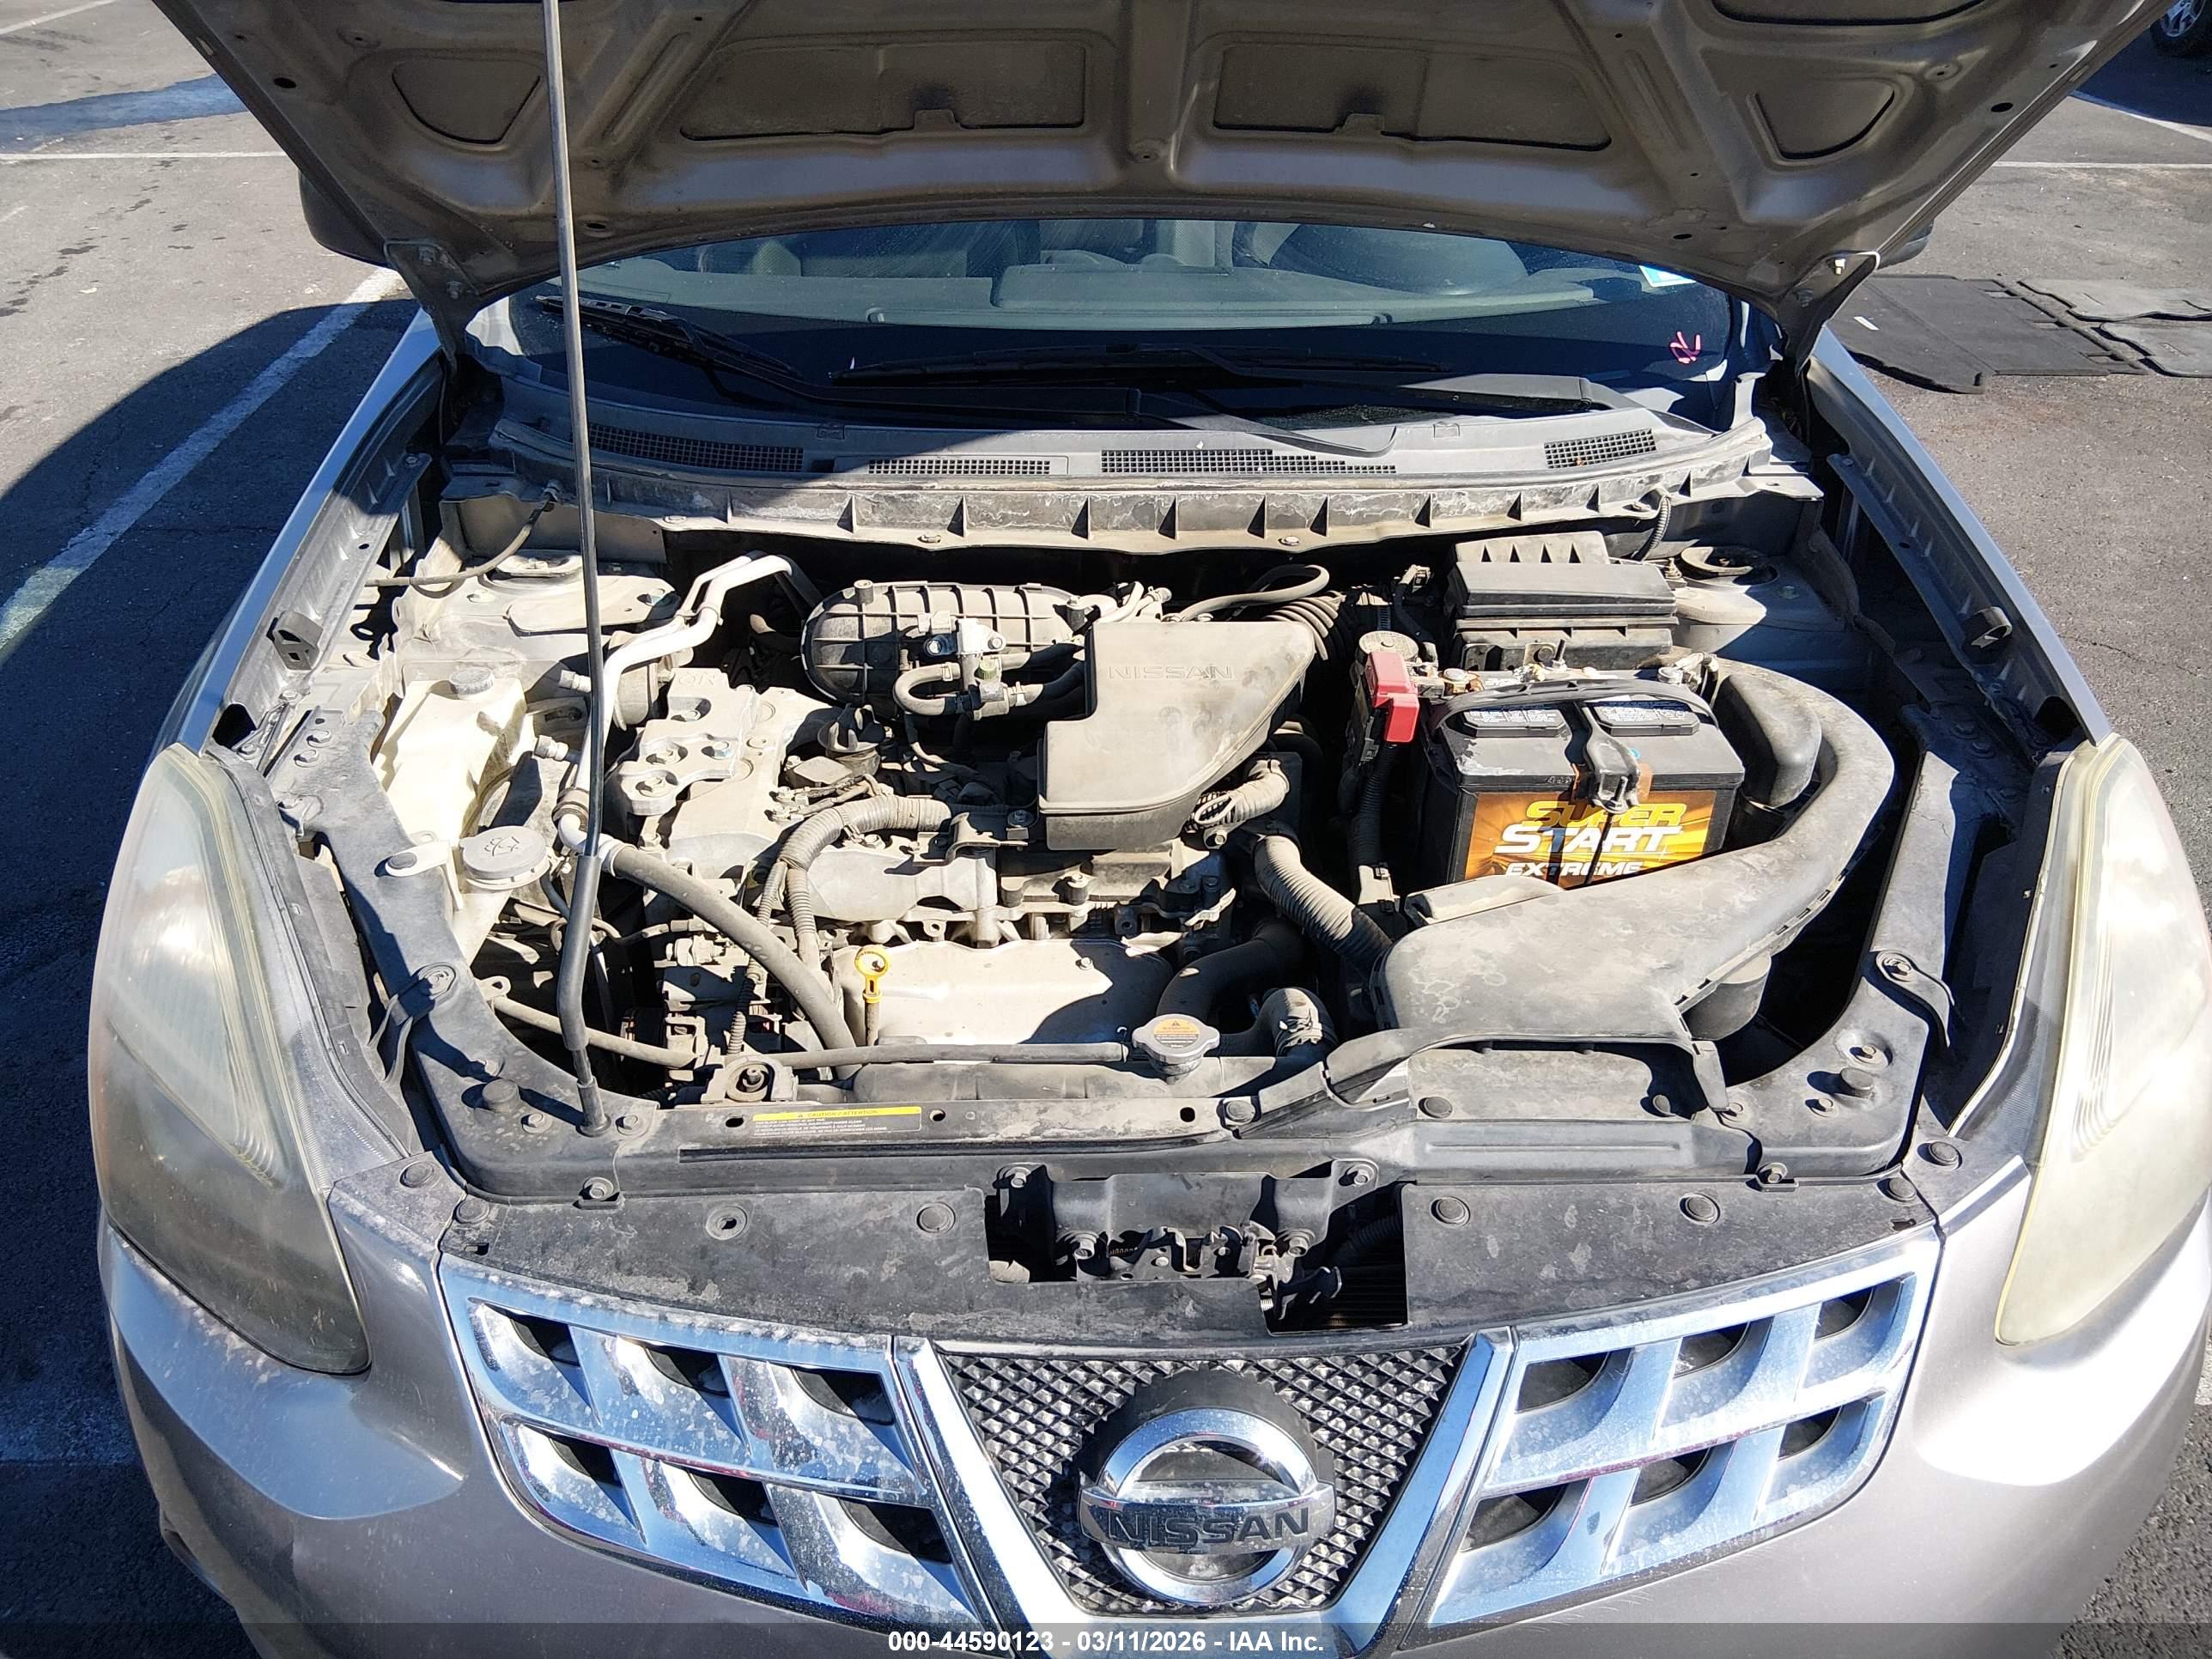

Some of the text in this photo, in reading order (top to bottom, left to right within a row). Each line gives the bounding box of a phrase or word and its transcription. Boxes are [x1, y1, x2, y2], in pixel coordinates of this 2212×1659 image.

[1109, 665, 1233, 679] NISSAN
[1494, 824, 1682, 854] START
[1505, 861, 1644, 877] EXTREME
[1109, 1507, 1309, 1547] NISSAN
